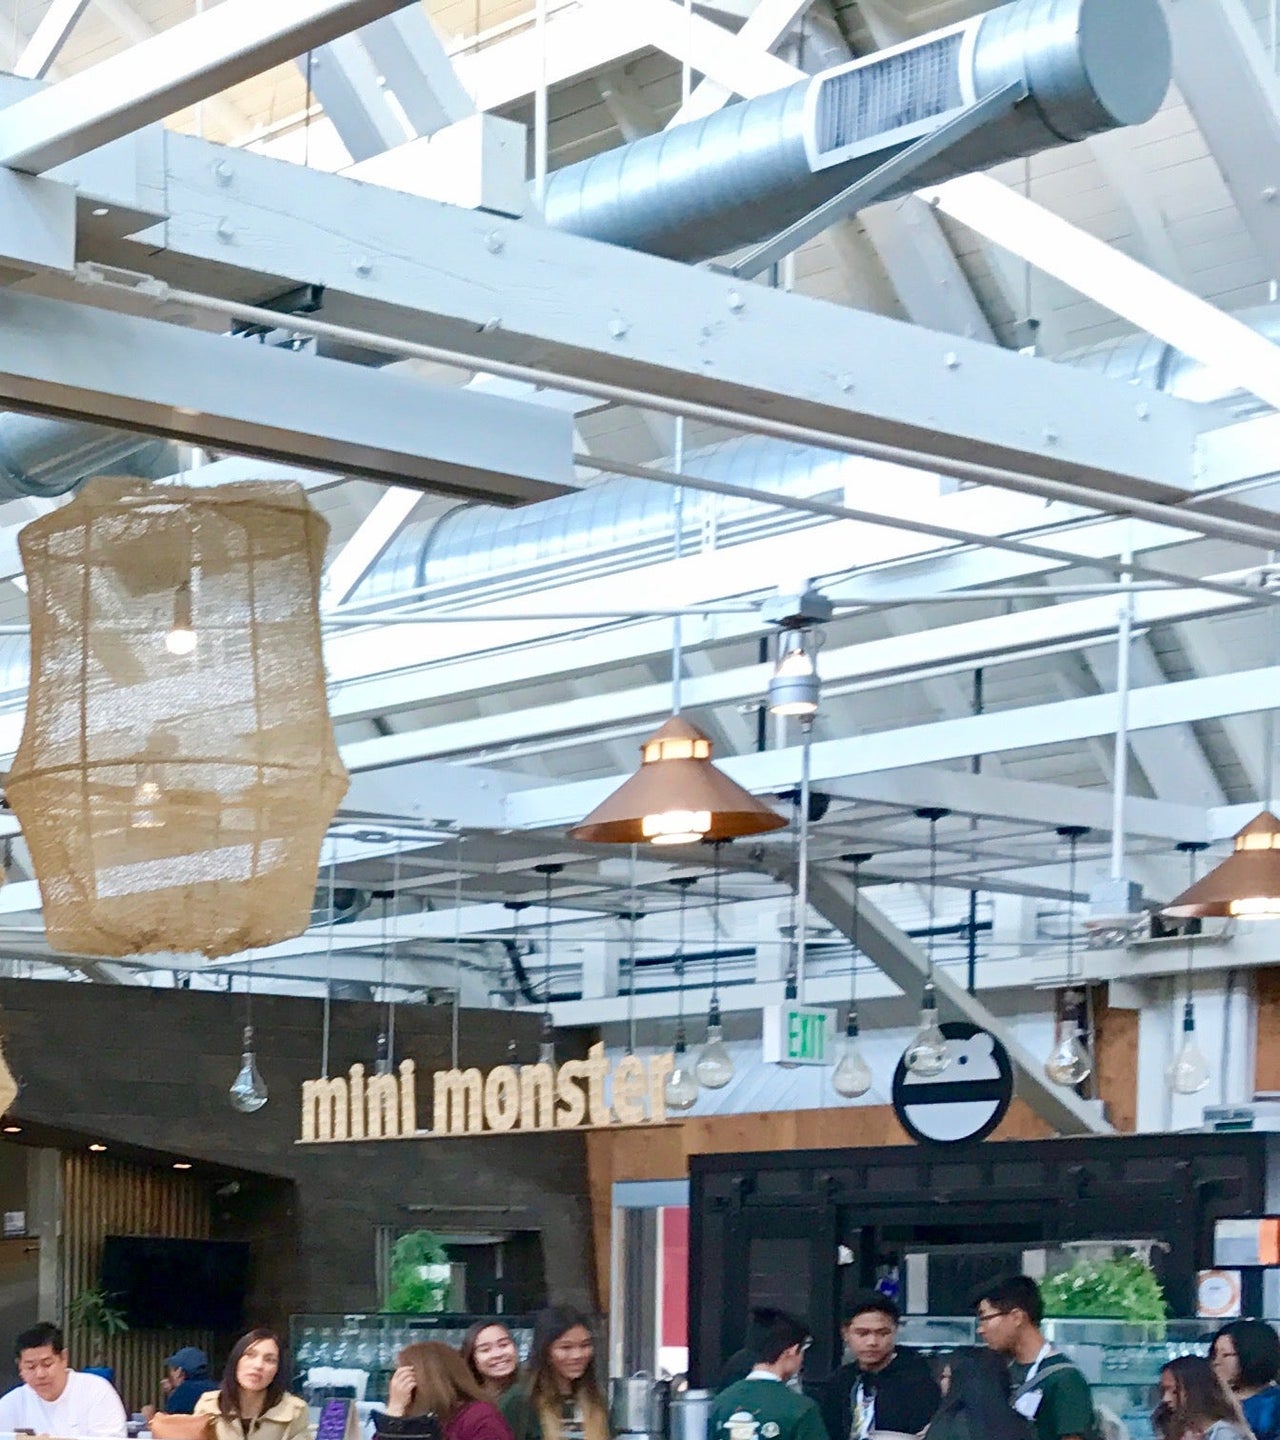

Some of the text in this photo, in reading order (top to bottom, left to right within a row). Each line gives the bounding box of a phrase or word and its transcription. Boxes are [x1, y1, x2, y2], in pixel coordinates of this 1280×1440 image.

[788, 1011, 827, 1060] EXIT
[302, 1040, 675, 1143] mini monster
